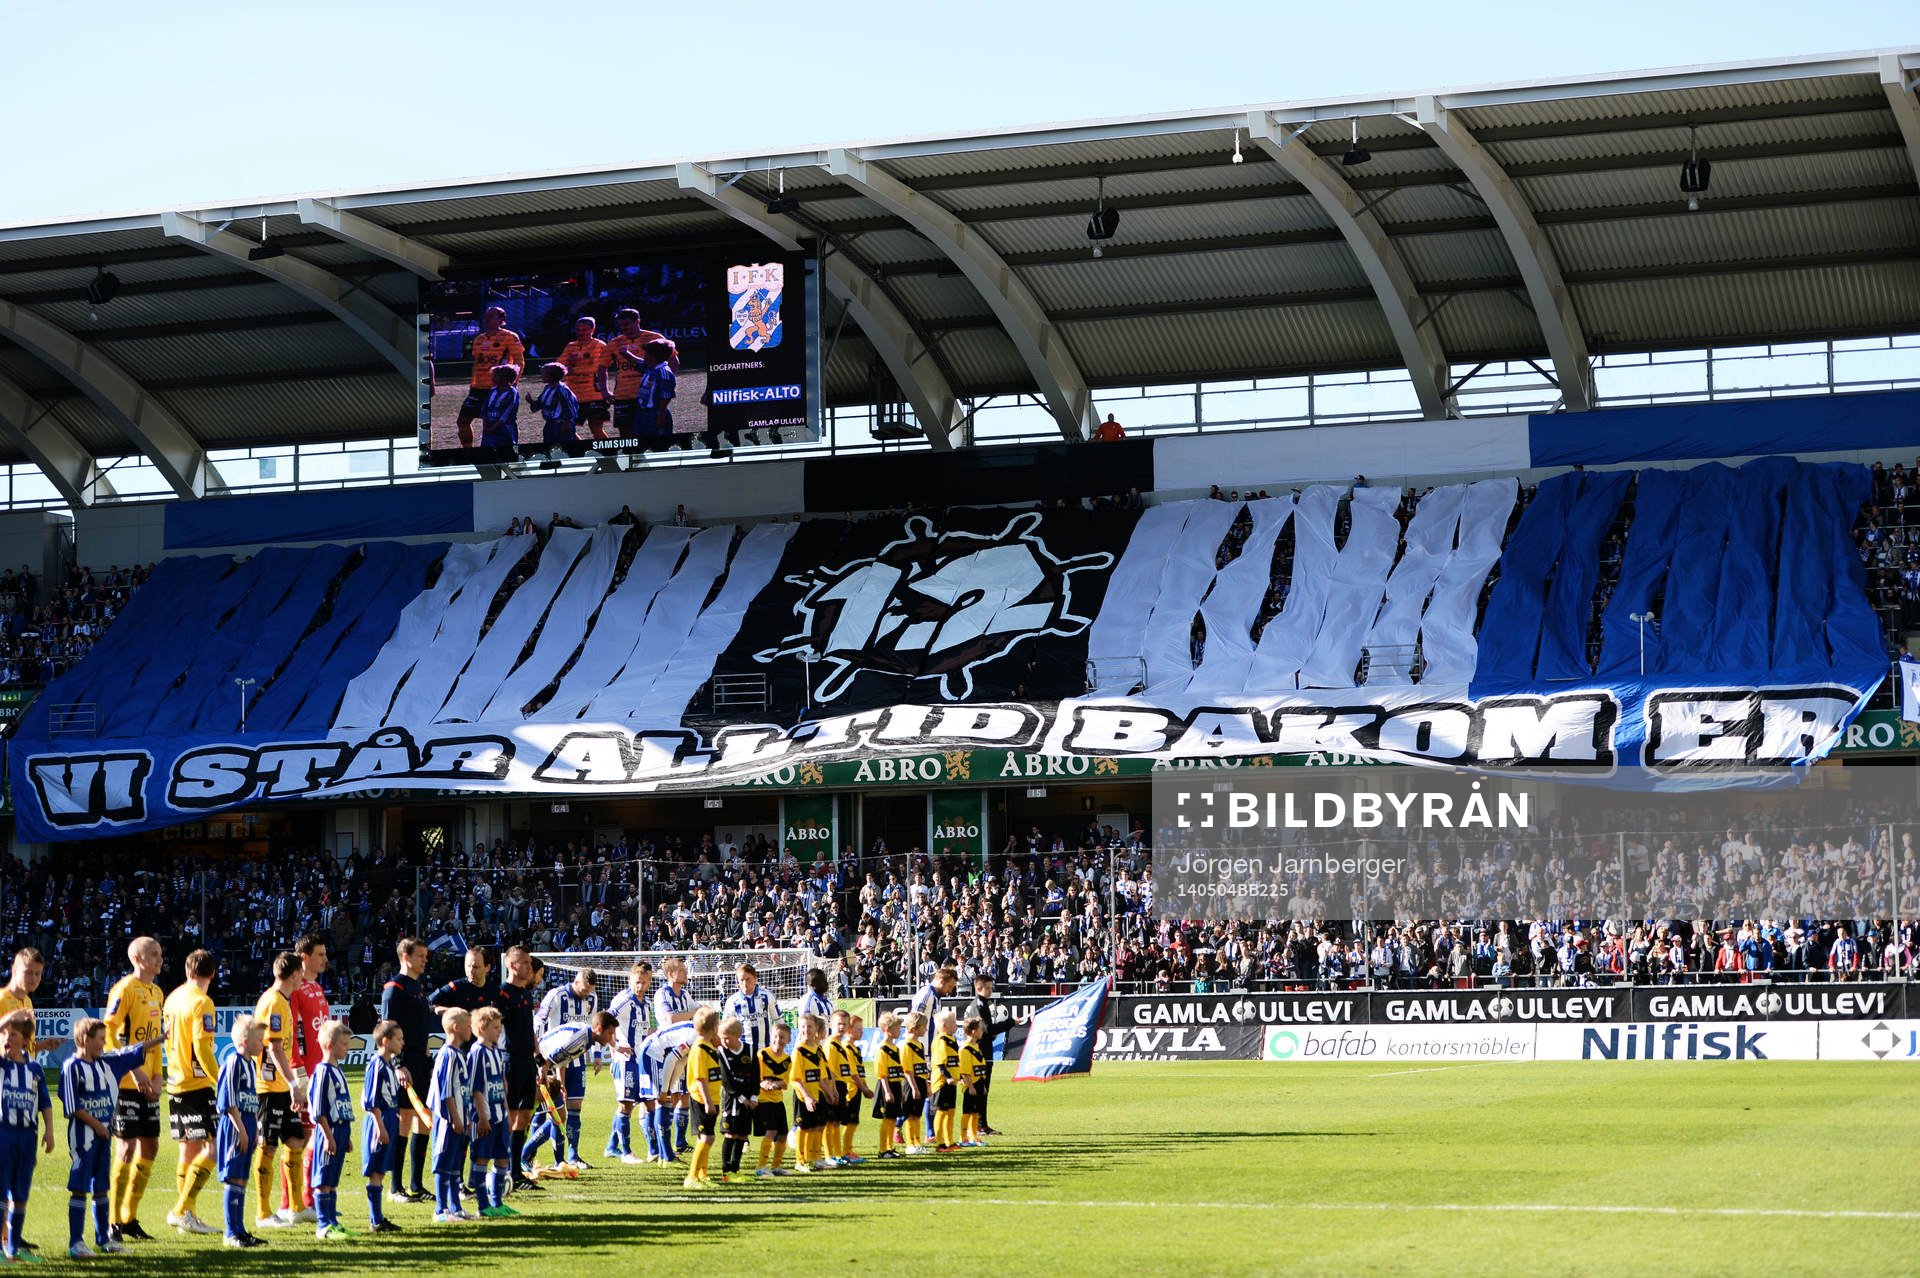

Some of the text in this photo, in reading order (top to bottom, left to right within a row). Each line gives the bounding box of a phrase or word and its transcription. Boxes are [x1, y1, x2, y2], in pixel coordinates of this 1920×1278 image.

[713, 385, 801, 404] Nilfisk-ALTO
[592, 438, 639, 451] SAMSUNG
[27, 751, 154, 830] VI
[168, 727, 516, 811] STÅR
[1069, 693, 1618, 776] BAKOM
[1000, 750, 1090, 777] ÅBRO
[786, 826, 830, 841] ÅBRO
[934, 825, 979, 840] ÅBRO
[1134, 1000, 1351, 1025] GAMLA ULLEVI
[1386, 996, 1613, 1021] GAMLA ULLEVI
[1649, 992, 1885, 1018] GAMLA ULLEVI
[1304, 1030, 1530, 1056] bafab kontorsmöbler
[1582, 1023, 1768, 1060] Nilfisk
